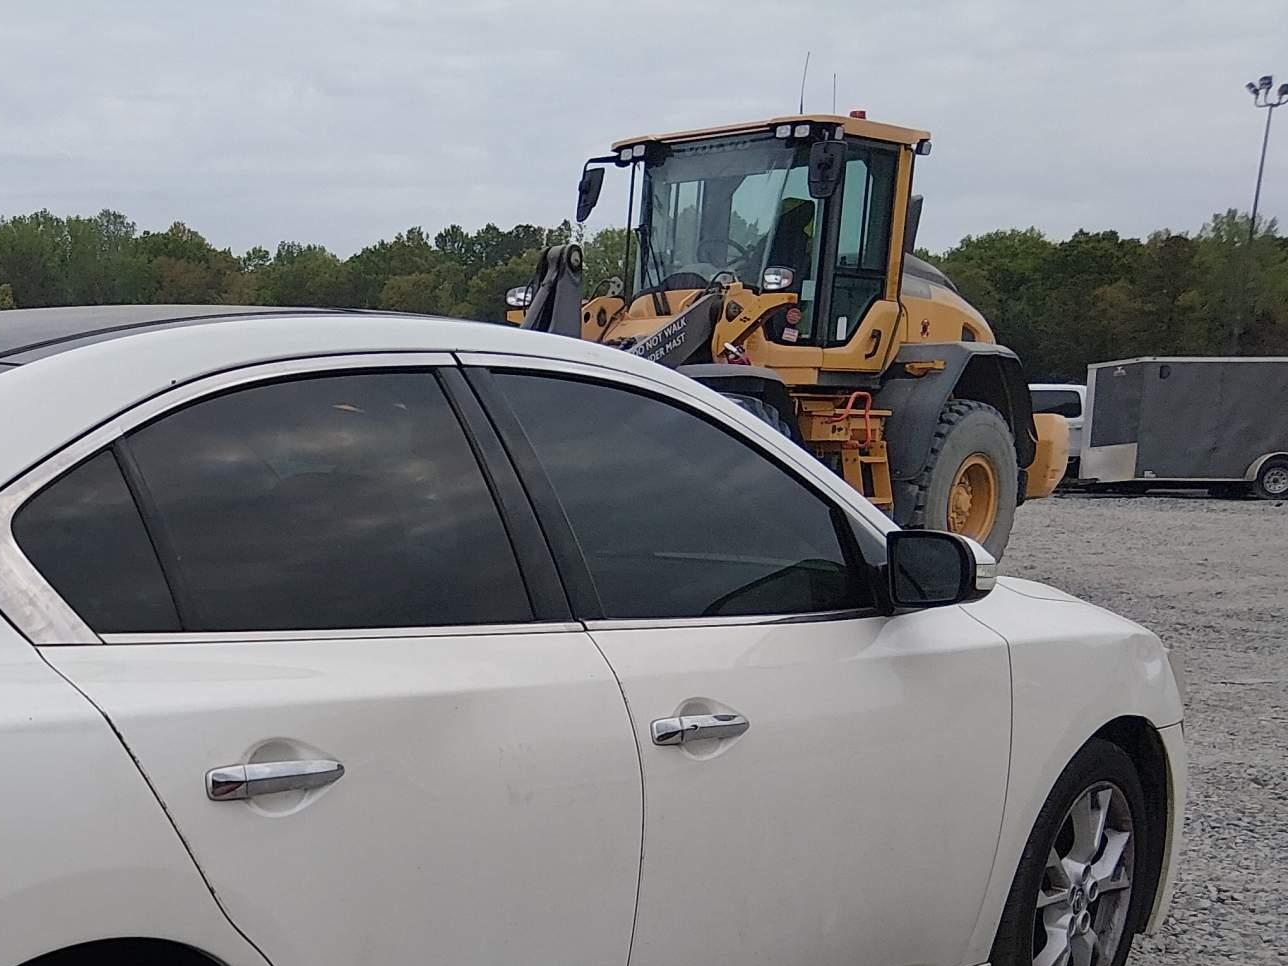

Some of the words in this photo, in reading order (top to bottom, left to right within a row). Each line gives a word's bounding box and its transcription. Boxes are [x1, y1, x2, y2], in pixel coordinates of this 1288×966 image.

[646, 332, 663, 350] NOT
[663, 317, 687, 337] WALK
[647, 347, 666, 361] DER
[665, 332, 686, 354] MAST
